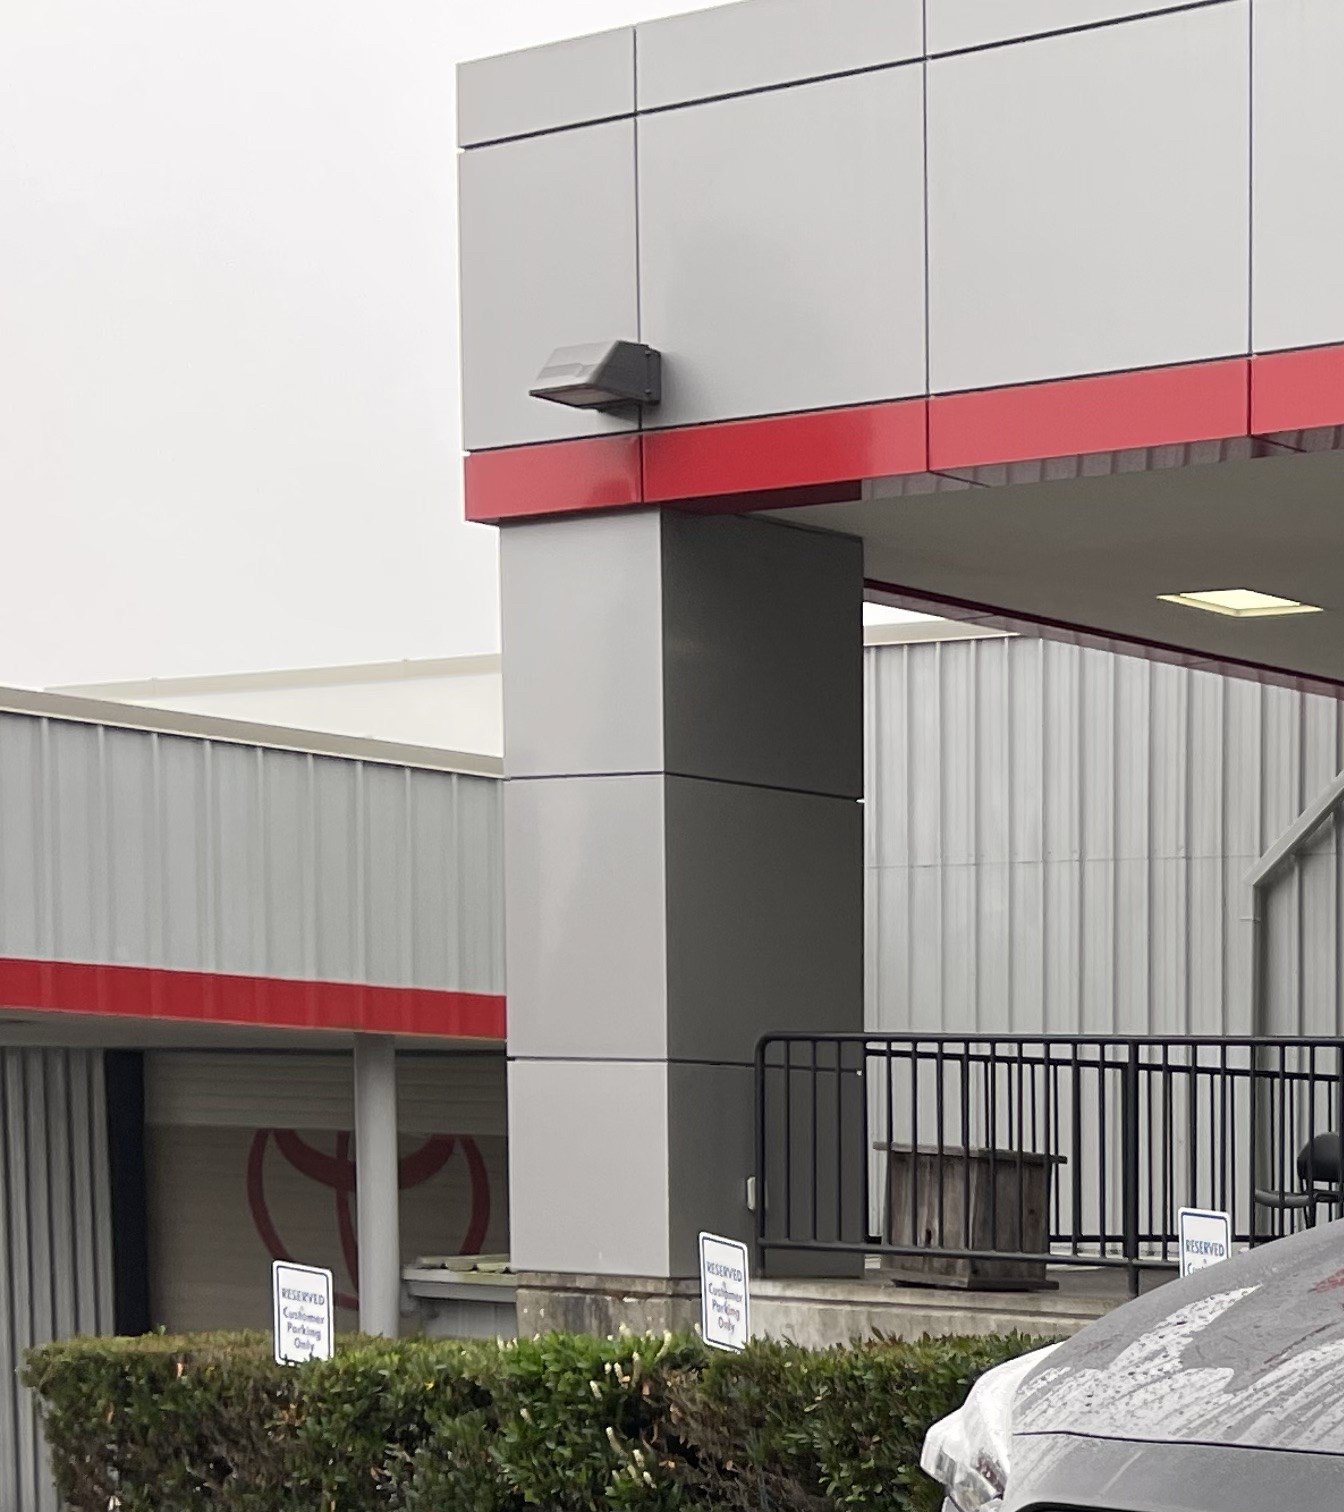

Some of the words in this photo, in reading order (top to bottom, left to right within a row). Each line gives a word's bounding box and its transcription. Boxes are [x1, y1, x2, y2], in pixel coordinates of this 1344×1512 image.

[1185, 1239, 1225, 1257] RESERVED
[706, 1260, 743, 1283] RESERVED
[281, 1287, 325, 1306] RESERVED
[708, 1282, 743, 1302] Customer
[282, 1306, 325, 1325] Customer
[712, 1299, 740, 1322] Parking
[287, 1322, 322, 1341] Parking
[718, 1316, 736, 1334] Only
[294, 1337, 315, 1352] Only
